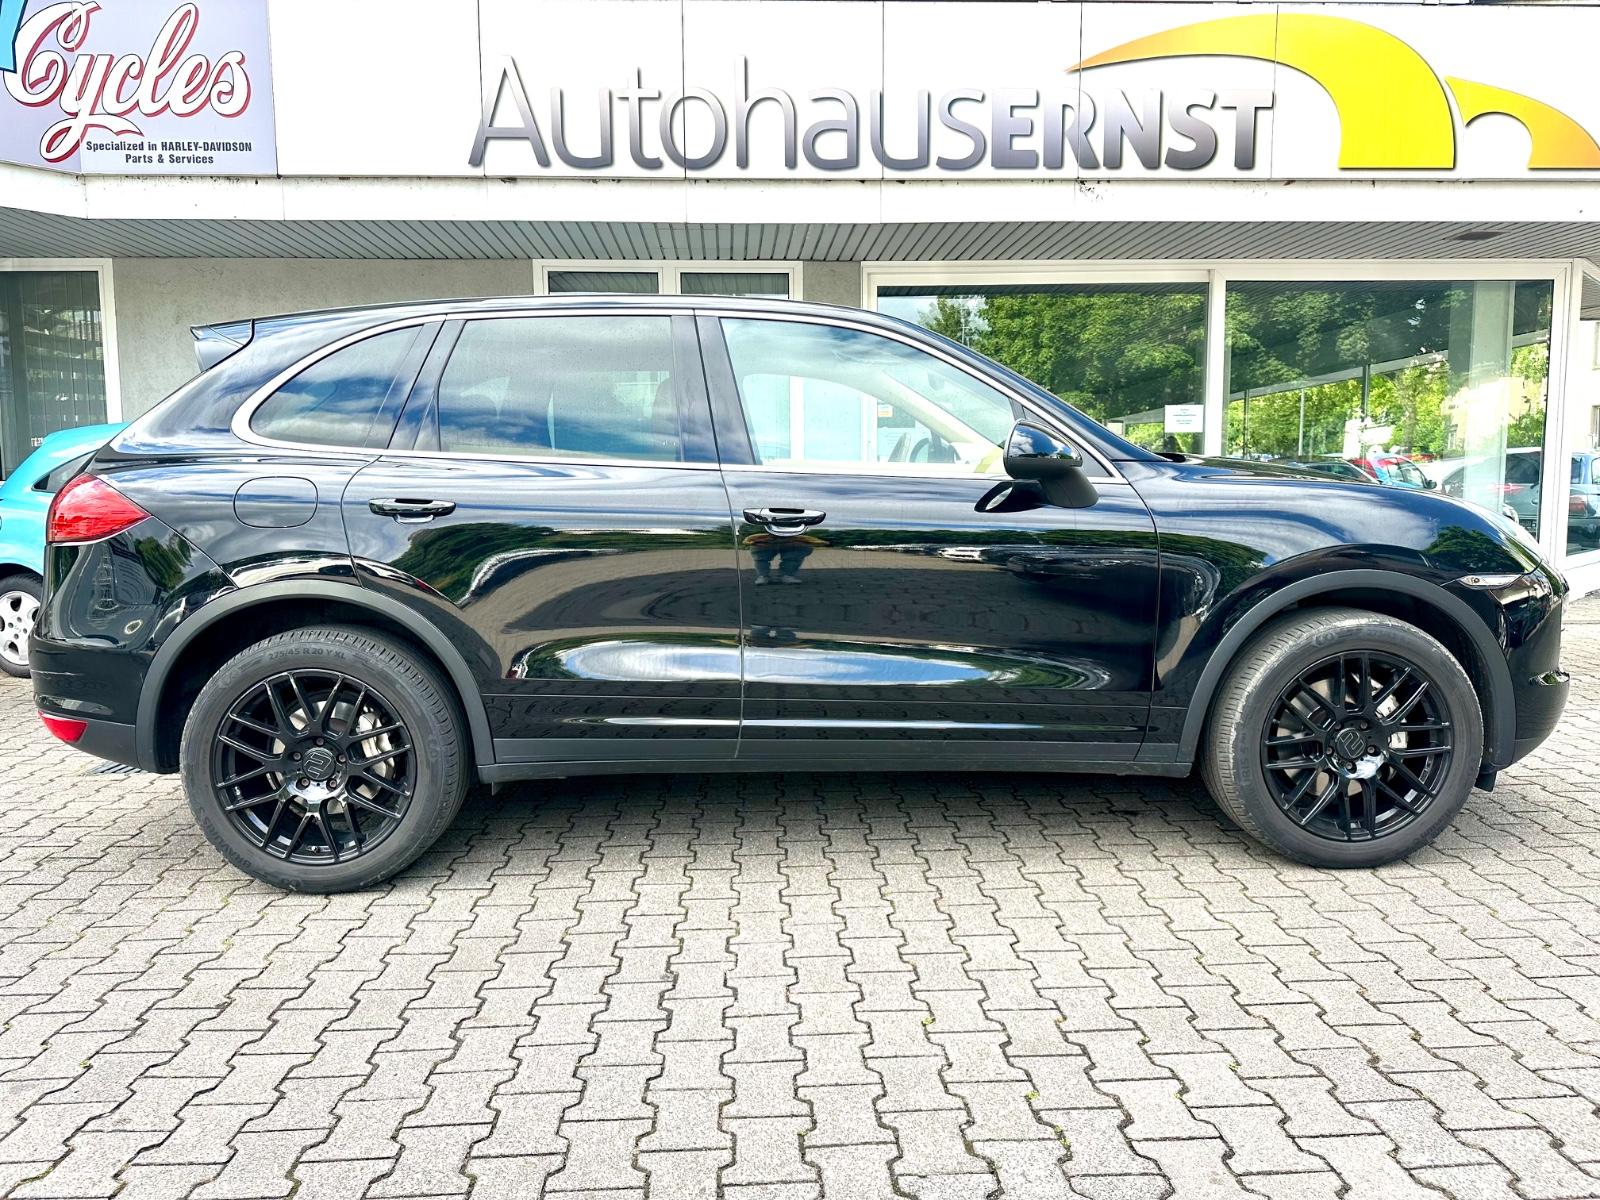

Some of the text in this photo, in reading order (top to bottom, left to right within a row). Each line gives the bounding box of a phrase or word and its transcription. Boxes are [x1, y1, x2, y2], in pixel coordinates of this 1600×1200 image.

[3, 1, 251, 163] Cycles
[86, 141, 252, 152] Specialized in HARLEY-DAVIDSON
[125, 154, 214, 164] Parts & Services
[268, 648, 300, 660] 275/45
[303, 647, 310, 655] R
[311, 647, 324, 656] 20
